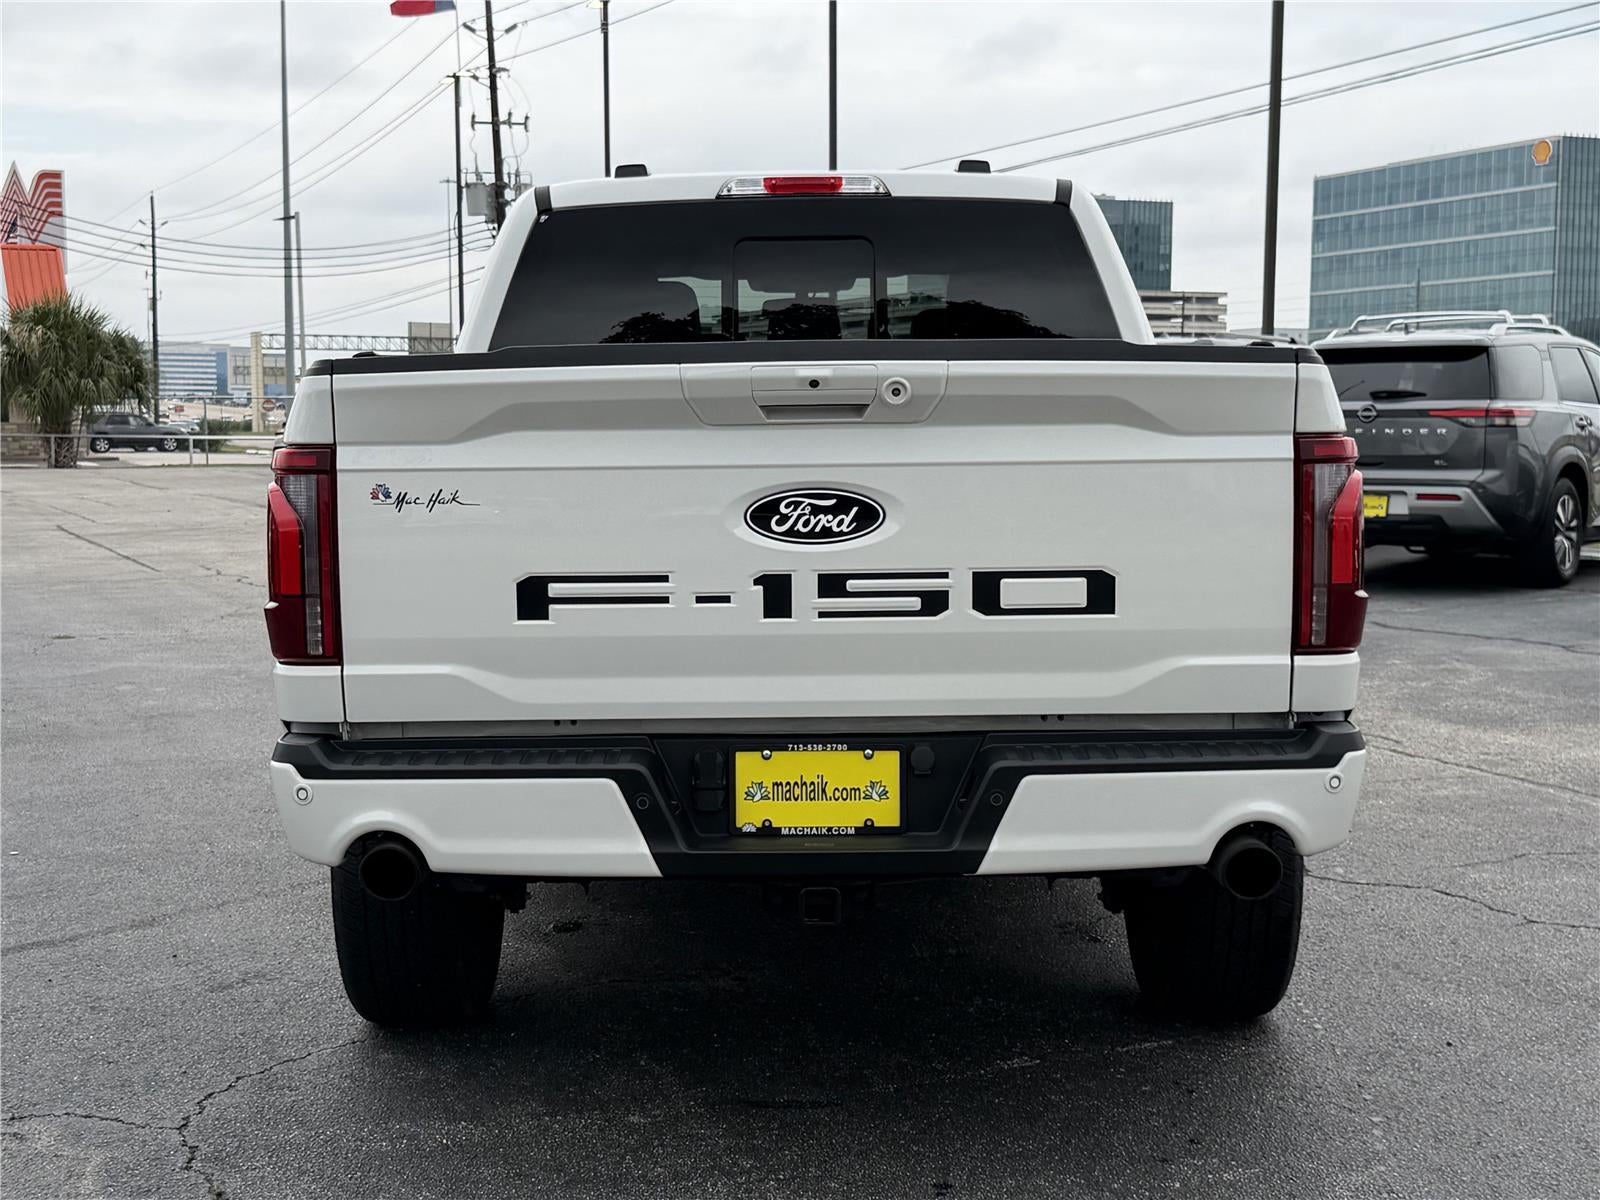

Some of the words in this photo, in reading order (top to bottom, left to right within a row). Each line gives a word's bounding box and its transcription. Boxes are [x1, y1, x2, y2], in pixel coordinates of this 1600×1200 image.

[393, 491, 425, 513] Mac
[426, 488, 480, 513] Haik
[769, 497, 857, 534] Ford
[514, 570, 1117, 621] F-150
[771, 775, 861, 802] machaik.com
[781, 827, 855, 835] MACHAIK.COM
